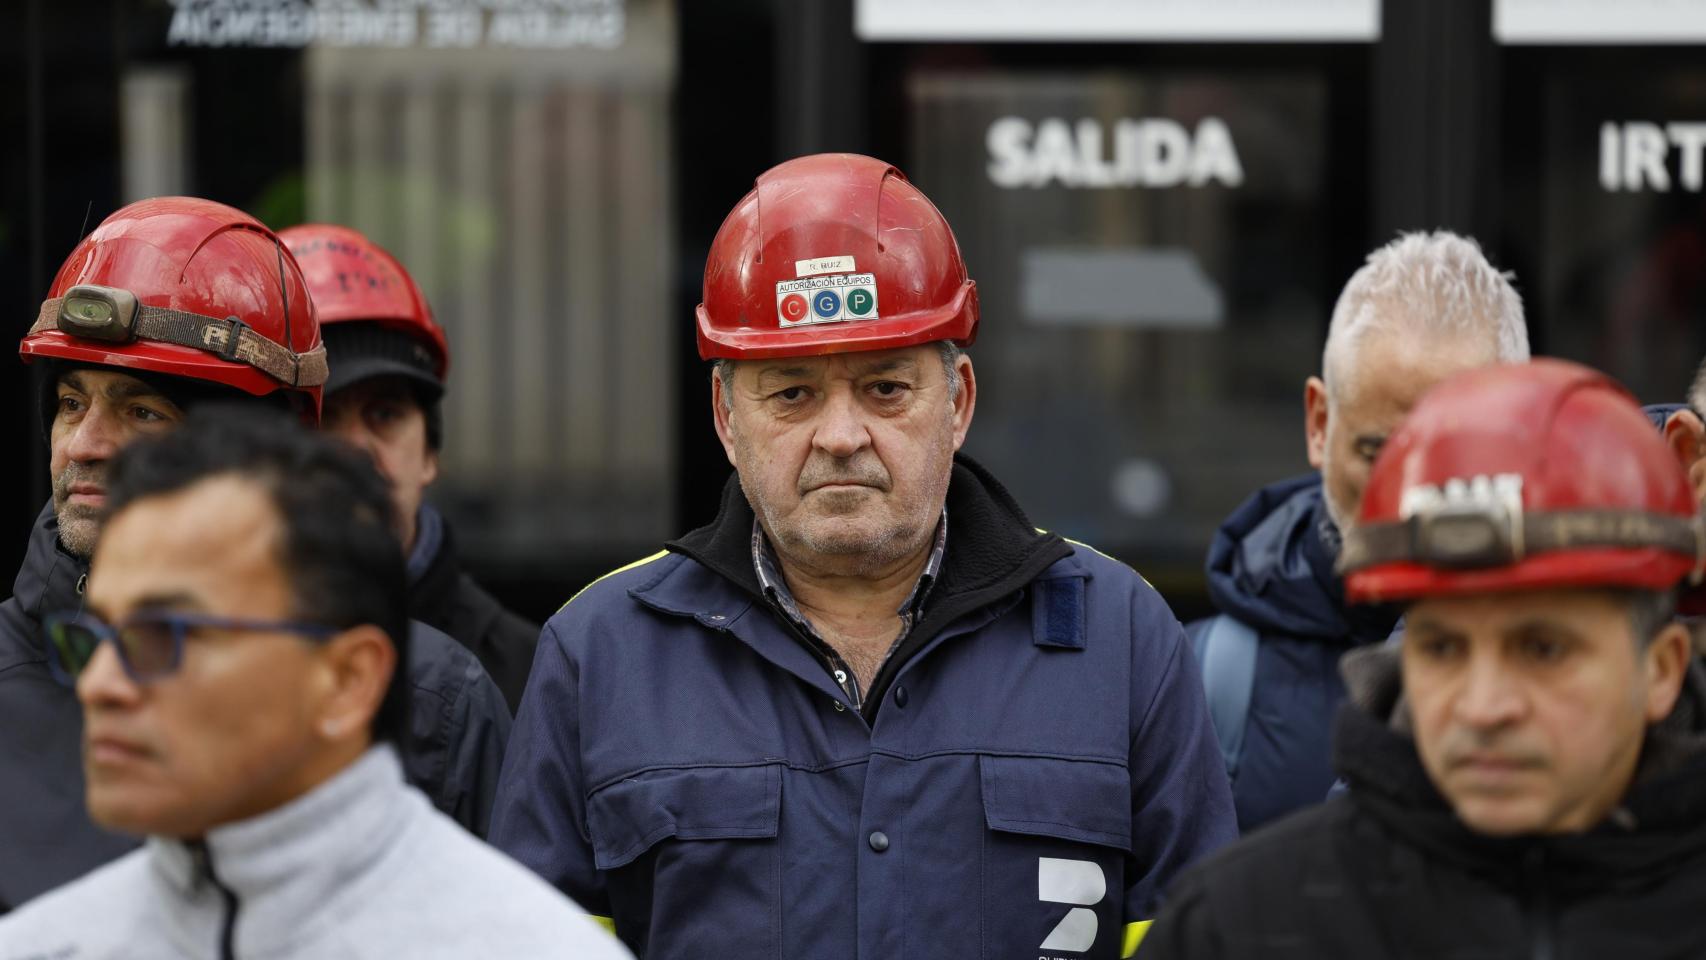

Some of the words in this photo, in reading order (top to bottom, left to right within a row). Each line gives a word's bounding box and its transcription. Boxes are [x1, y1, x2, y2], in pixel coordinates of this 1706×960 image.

[986, 117, 1244, 188] SALIDA
[1599, 122, 1706, 191] IRT
[821, 261, 841, 269] RUIZ
[780, 279, 835, 292] AUTORIZACIÓN
[838, 276, 870, 286] EQUIPOS
[787, 301, 800, 316] C
[820, 297, 834, 312] G
[854, 294, 866, 310] P
